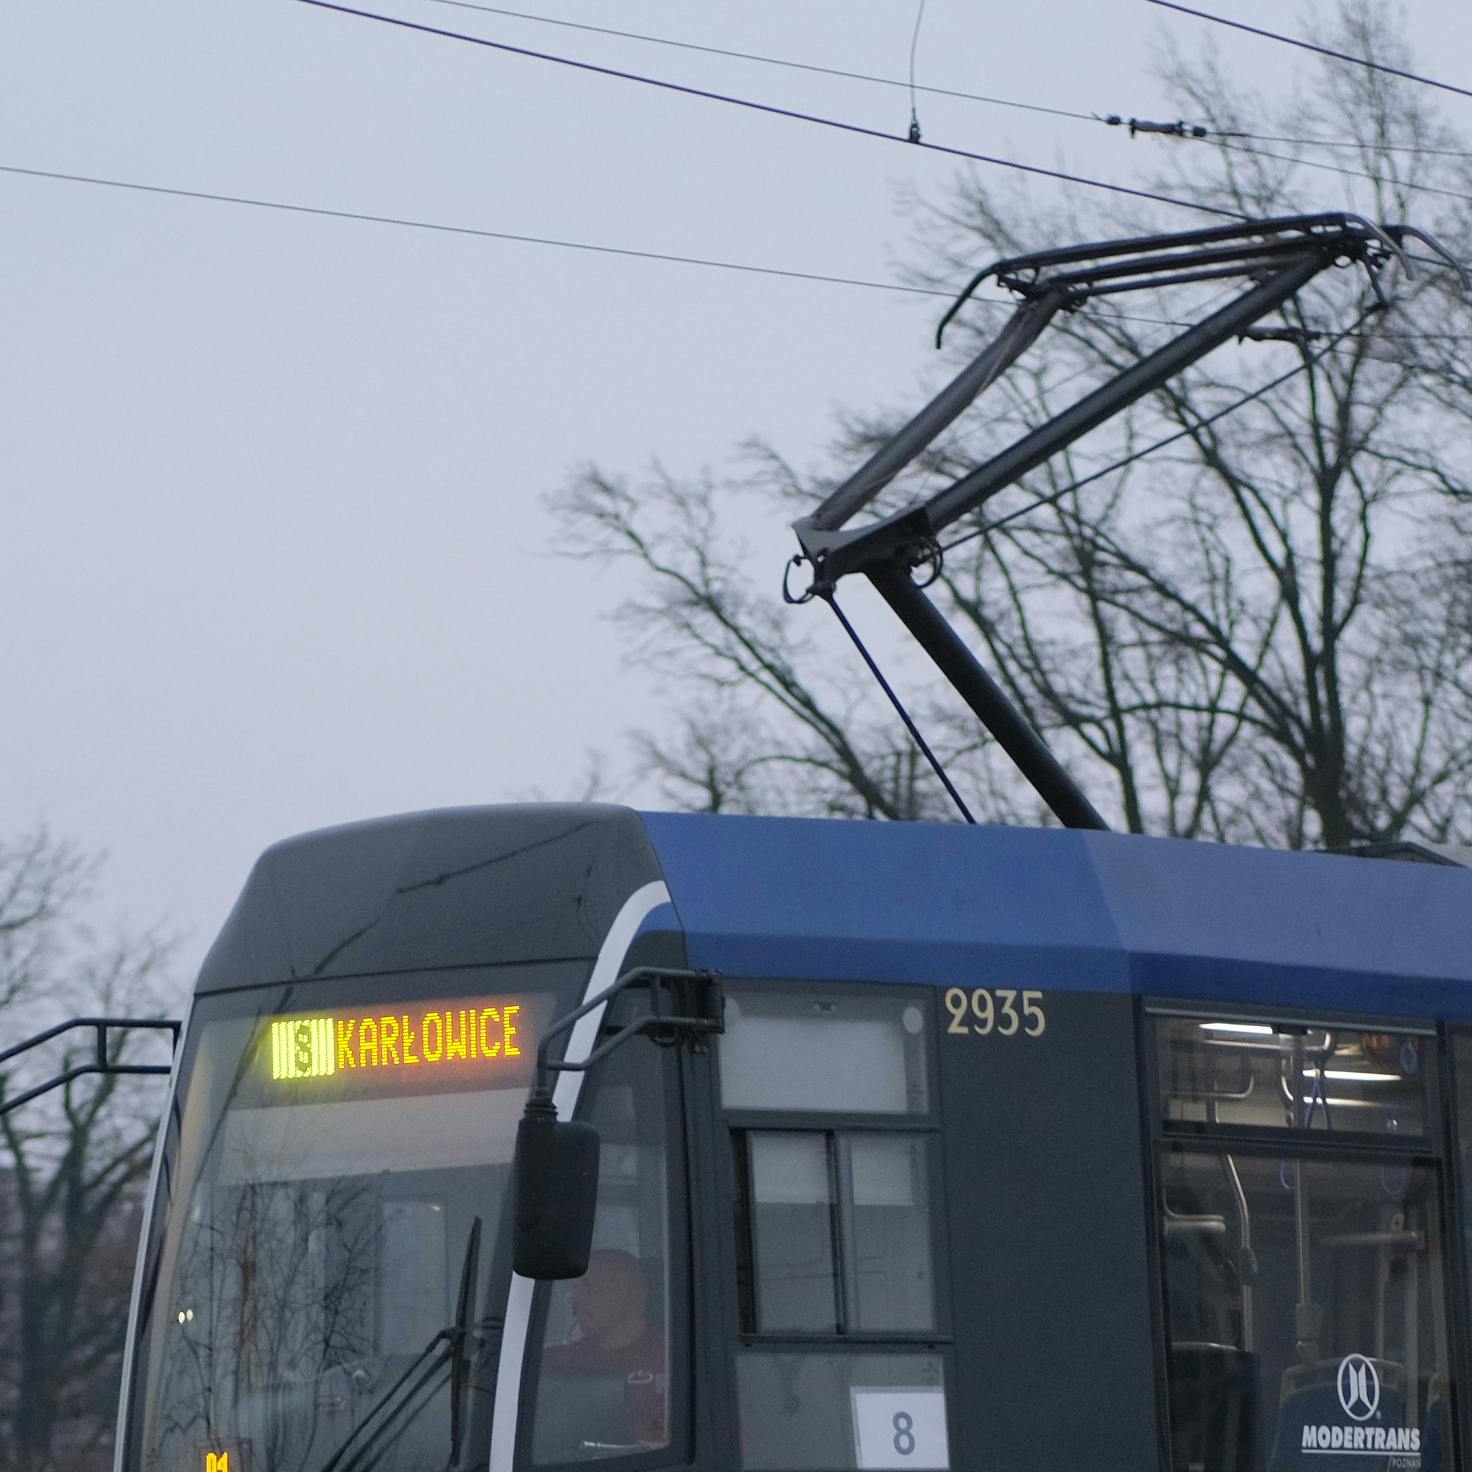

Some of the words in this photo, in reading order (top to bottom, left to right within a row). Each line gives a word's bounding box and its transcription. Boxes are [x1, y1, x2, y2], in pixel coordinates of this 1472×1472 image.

[944, 987, 1046, 1037] 2935
[295, 1024, 313, 1073] 8
[336, 1004, 521, 1070] KARŁOWICE
[892, 1411, 916, 1456] 8
[1301, 1424, 1421, 1451] MODERTRANS
